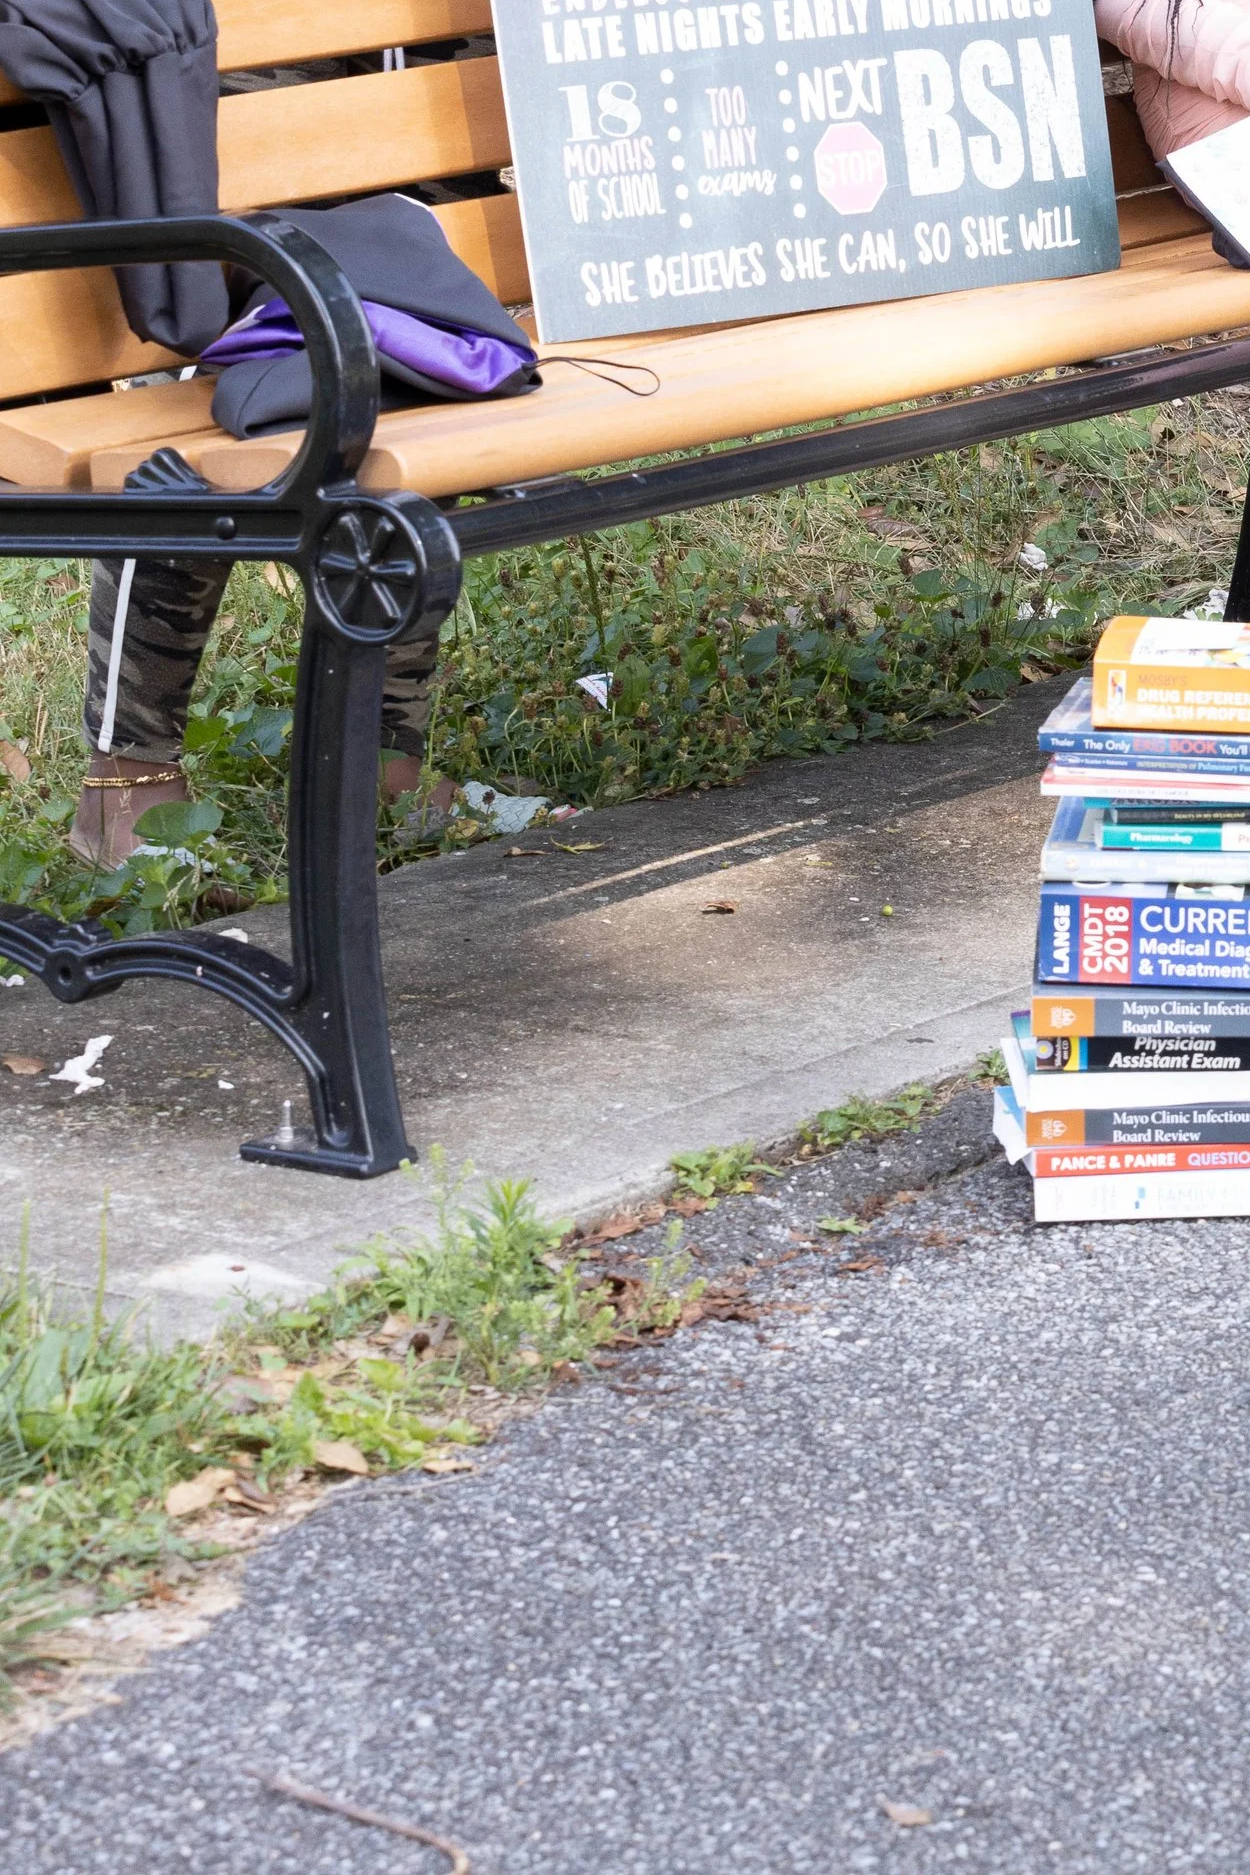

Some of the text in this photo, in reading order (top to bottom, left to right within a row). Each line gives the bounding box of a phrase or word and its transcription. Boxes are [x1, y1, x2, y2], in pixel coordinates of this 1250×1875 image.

[542, 16, 625, 63] LATE
[636, 5, 764, 53] NIGHTS
[798, 59, 887, 122] NEXT
[559, 81, 642, 142] 18
[706, 86, 746, 127] TOO
[894, 35, 1086, 197] BSN
[562, 136, 654, 178] MONTHS
[701, 125, 757, 171] MANY
[817, 149, 882, 187] STOP
[697, 165, 776, 199] exams
[570, 174, 665, 224] OF SCHOOL
[581, 206, 1080, 307] SHE BELIEVES SHE CAN, SO SHE WILL
[1137, 688, 1181, 703] DRUG
[1136, 703, 1194, 720] HEALTH
[1050, 737, 1076, 747] Thaler
[1083, 739, 1103, 751] The
[1105, 739, 1131, 754] Only
[1169, 738, 1218, 755] BOOK
[1219, 743, 1248, 756] You'll
[1198, 762, 1238, 774] Pulmonary
[1053, 904, 1070, 974] LANGE
[1083, 903, 1103, 974] CMDT
[1104, 905, 1130, 974] 2018
[1139, 938, 1210, 957] Medical
[1138, 958, 1250, 979] & Treatment
[1122, 1001, 1159, 1019] Mayo
[1161, 1001, 1201, 1016] Clinic
[1122, 1020, 1212, 1034] Board Review
[1134, 1037, 1216, 1054] Physician
[1108, 1052, 1241, 1069] Assistant Exam
[1112, 1112, 1149, 1128] Mayo
[1151, 1111, 1191, 1125] Clinic
[1112, 1128, 1202, 1143] Board Review
[1051, 1155, 1106, 1171] PANCE
[1108, 1155, 1121, 1169] &
[1124, 1152, 1177, 1168] PANRE
